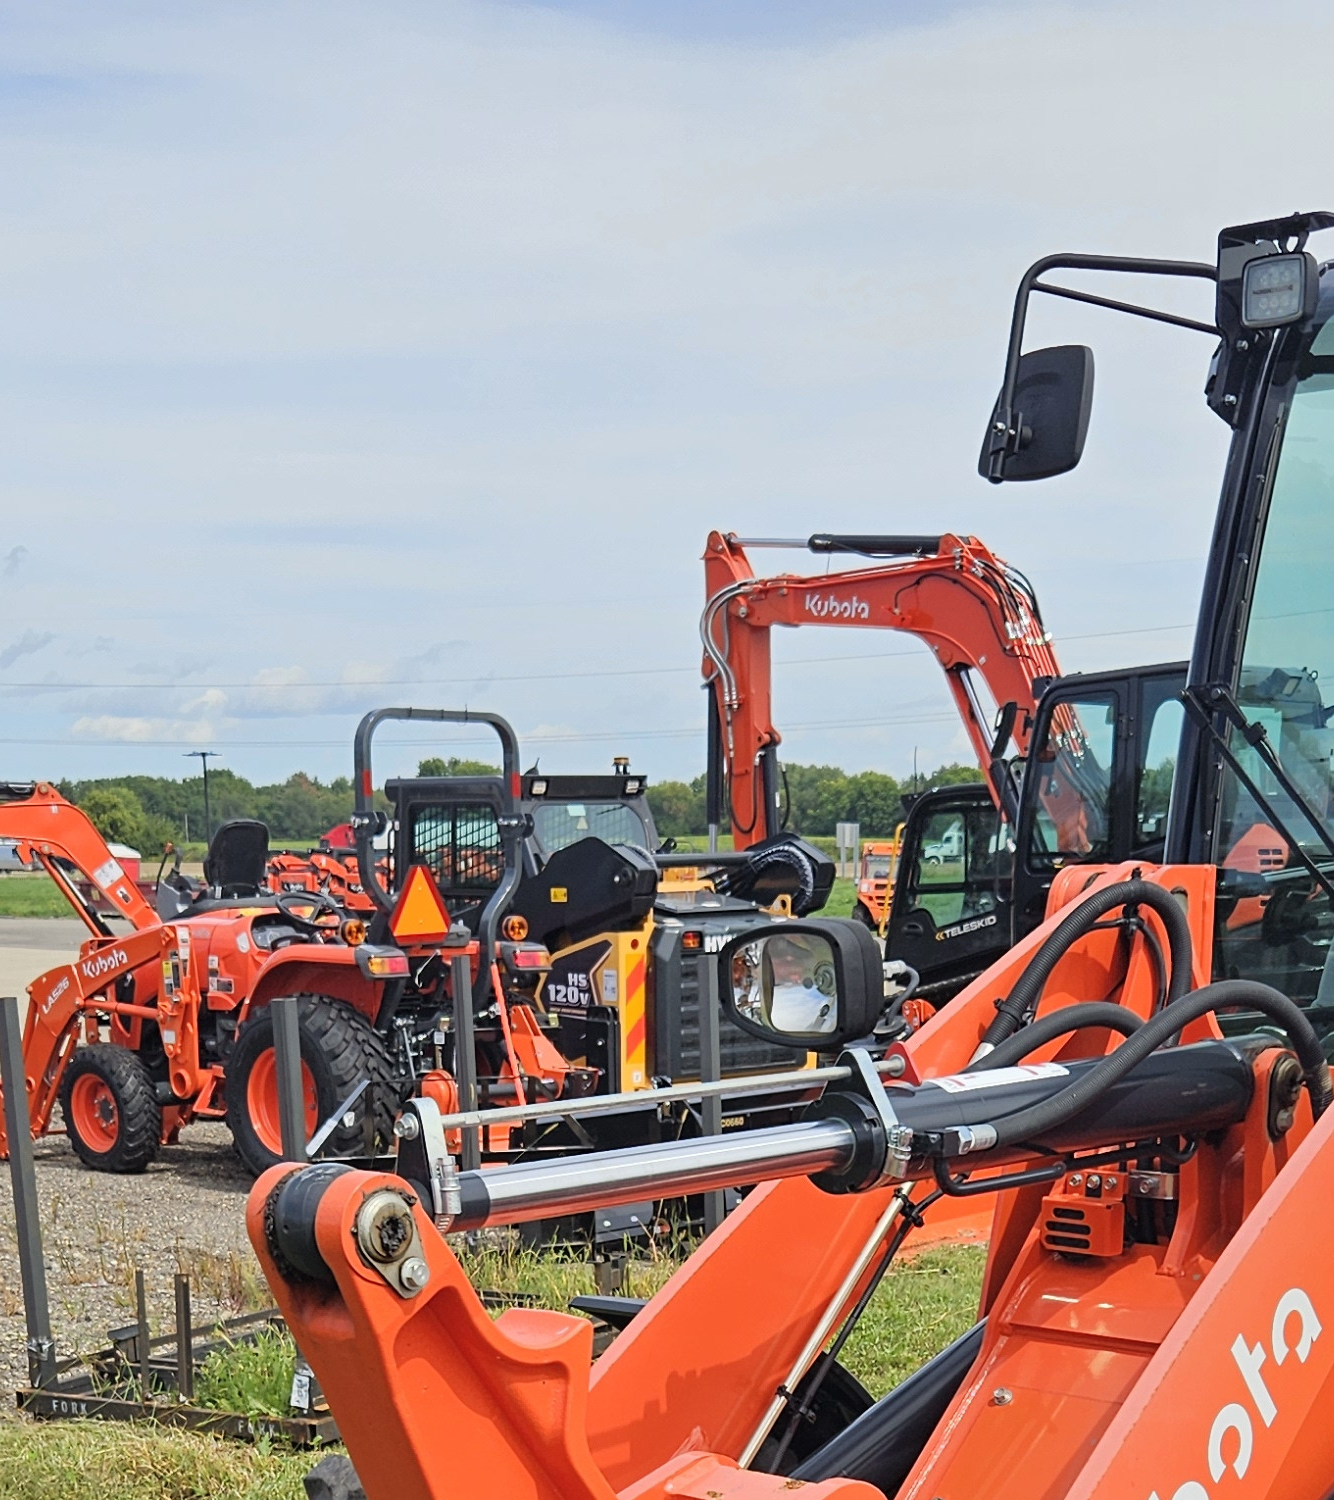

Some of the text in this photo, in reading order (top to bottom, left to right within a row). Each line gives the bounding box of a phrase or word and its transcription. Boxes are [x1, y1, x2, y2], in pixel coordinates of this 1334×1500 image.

[805, 593, 870, 619] Kubota
[944, 915, 997, 939] TELESKID
[82, 949, 128, 978] Kubota
[567, 972, 588, 987] HS
[42, 976, 70, 1015] LA526
